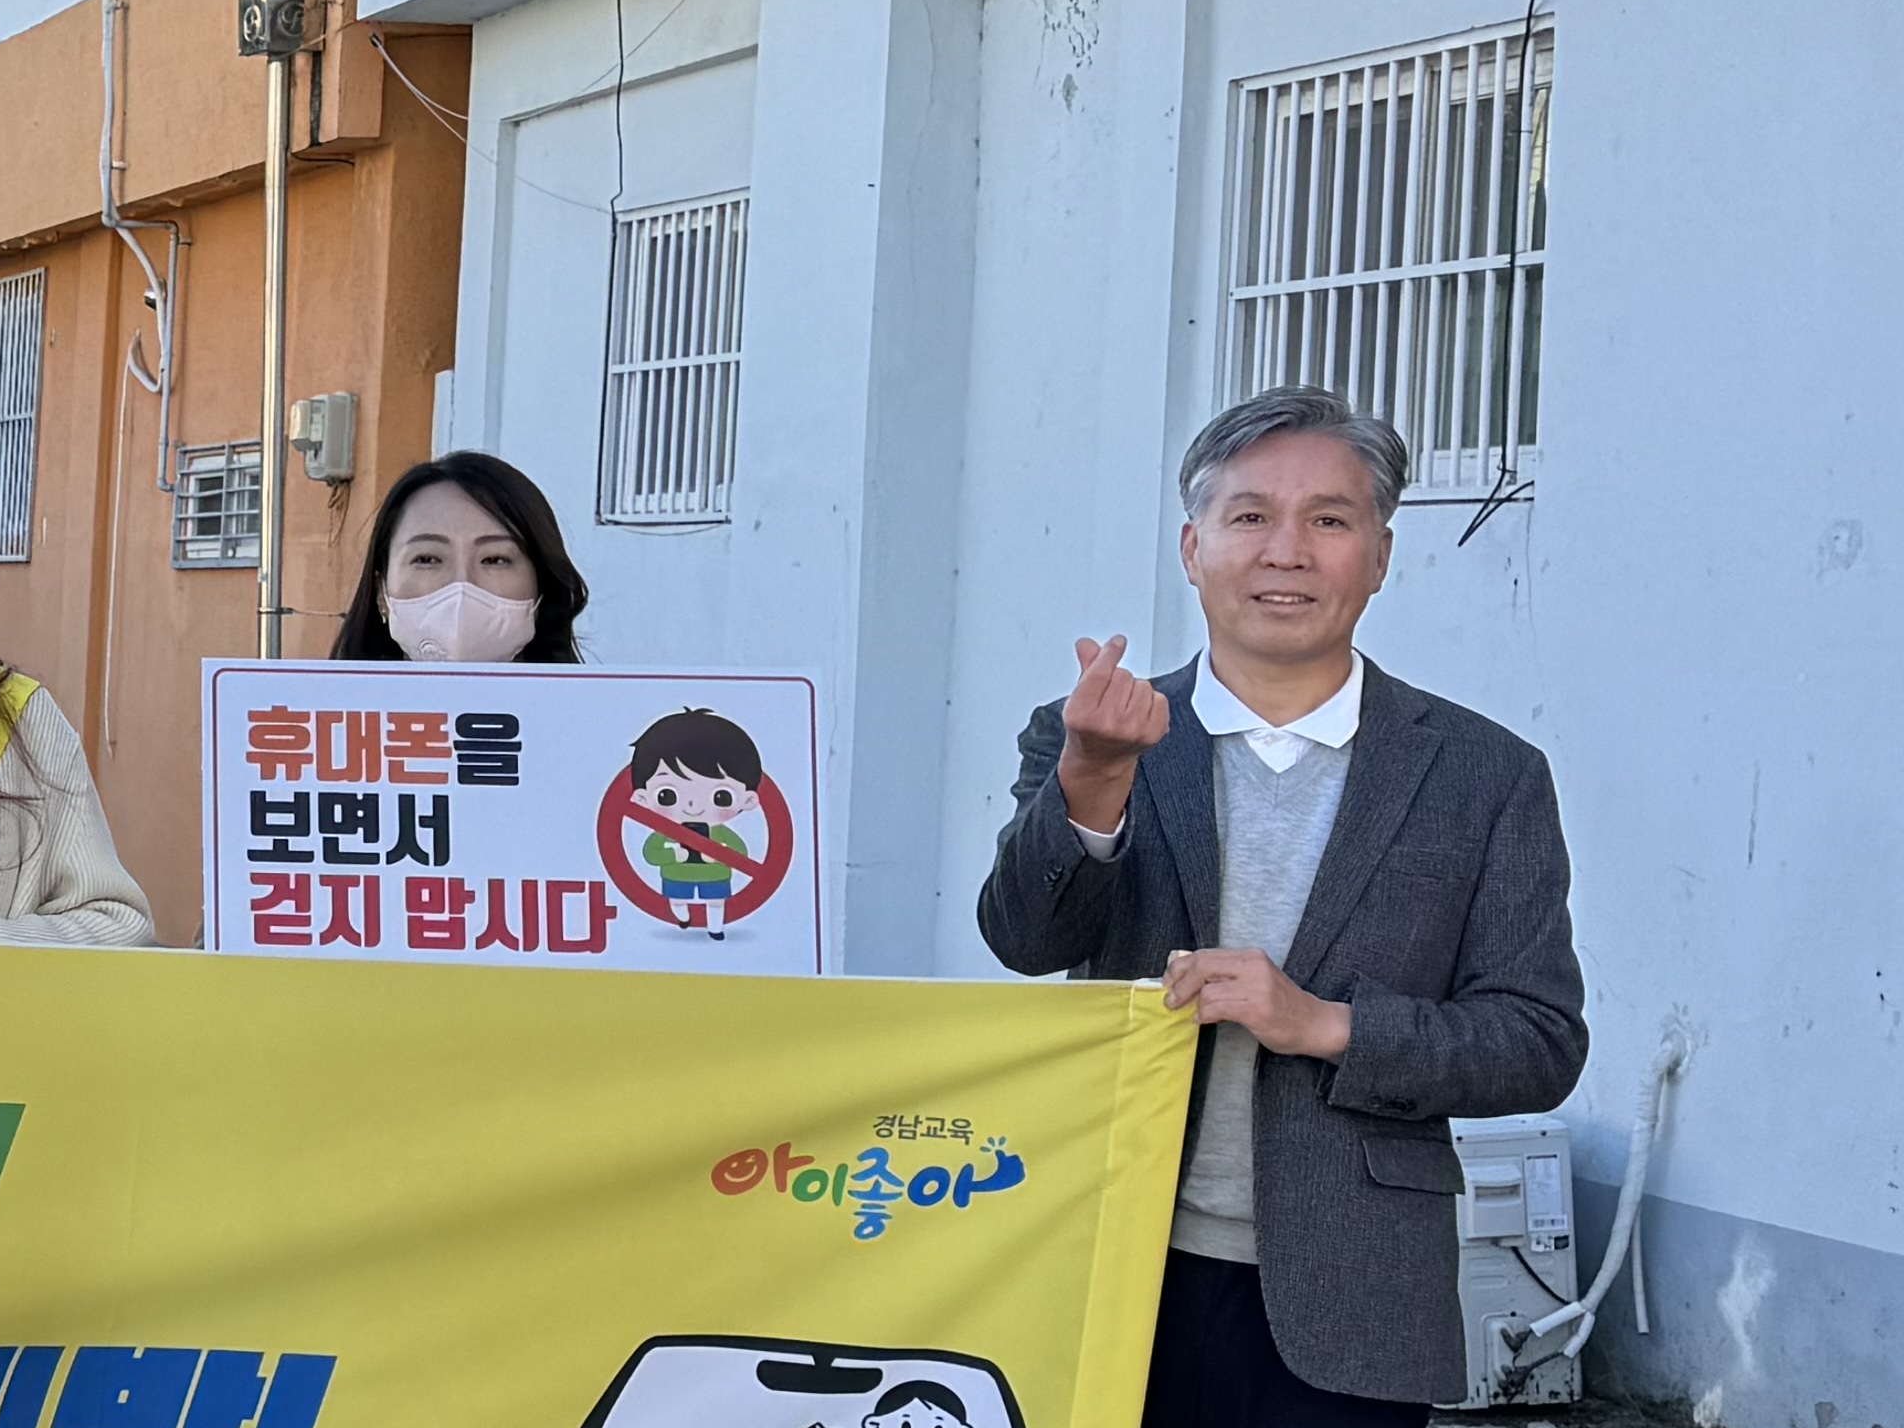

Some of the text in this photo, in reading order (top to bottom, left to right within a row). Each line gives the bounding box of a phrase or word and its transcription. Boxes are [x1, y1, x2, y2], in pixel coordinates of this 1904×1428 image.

[245, 705, 523, 786] 휴대폰을
[247, 789, 451, 867] 보면서
[248, 872, 617, 955] 걷지 맙시다
[873, 1114, 974, 1145] 경남교육
[710, 1141, 1026, 1240] 아이좋아
